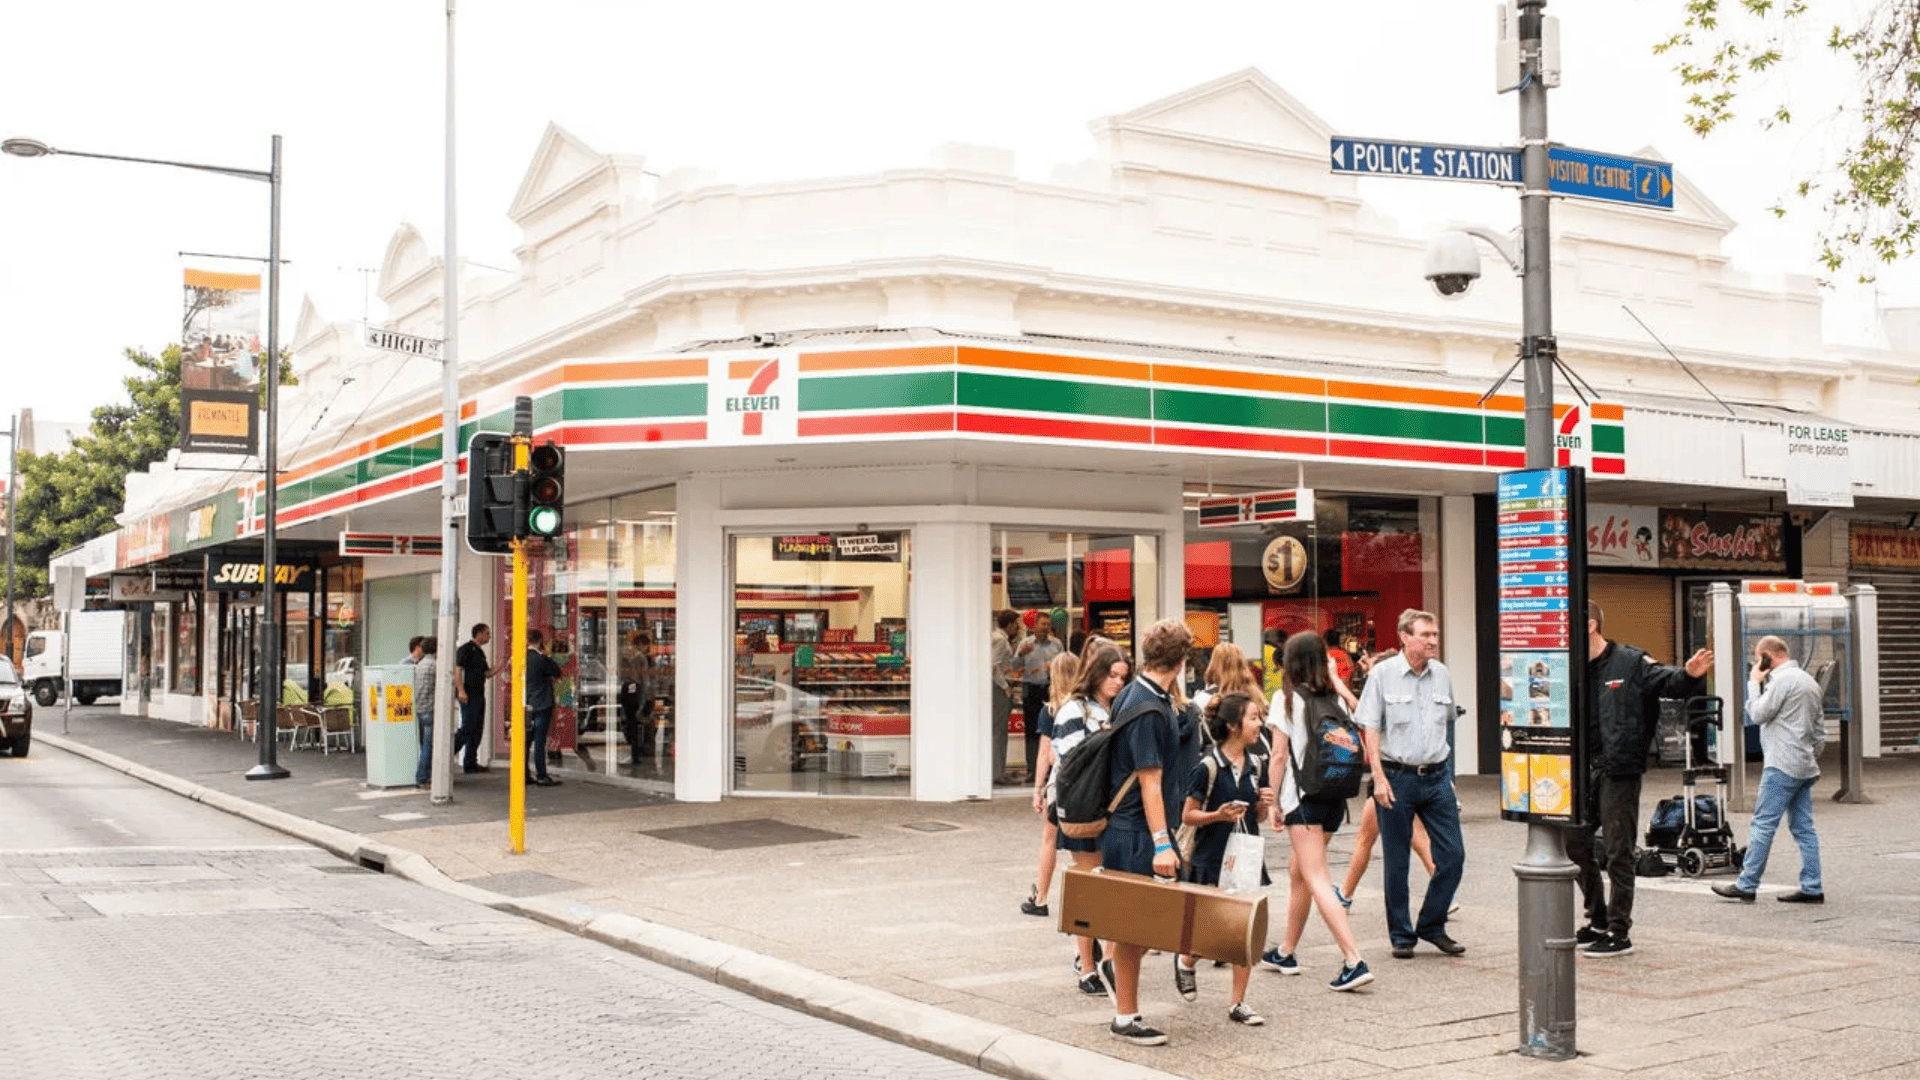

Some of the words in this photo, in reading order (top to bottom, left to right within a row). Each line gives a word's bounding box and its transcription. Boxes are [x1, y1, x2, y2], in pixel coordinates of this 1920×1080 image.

[1353, 143, 1423, 175] POLICE
[1434, 149, 1513, 181] STATION
[1548, 159, 1588, 185] VISITOR
[1593, 164, 1633, 192] CENTRE
[380, 333, 424, 354] HIGH
[1788, 425, 1811, 439] FOR
[1813, 427, 1848, 442] LEASE
[1788, 443, 1813, 456] prime
[1816, 444, 1849, 457] position
[847, 536, 877, 546] WEEKS
[851, 544, 896, 553] FLAVOURS
[1690, 521, 1756, 558] Sushi
[1856, 534, 1898, 558] PRICE
[1266, 540, 1293, 581] $1
